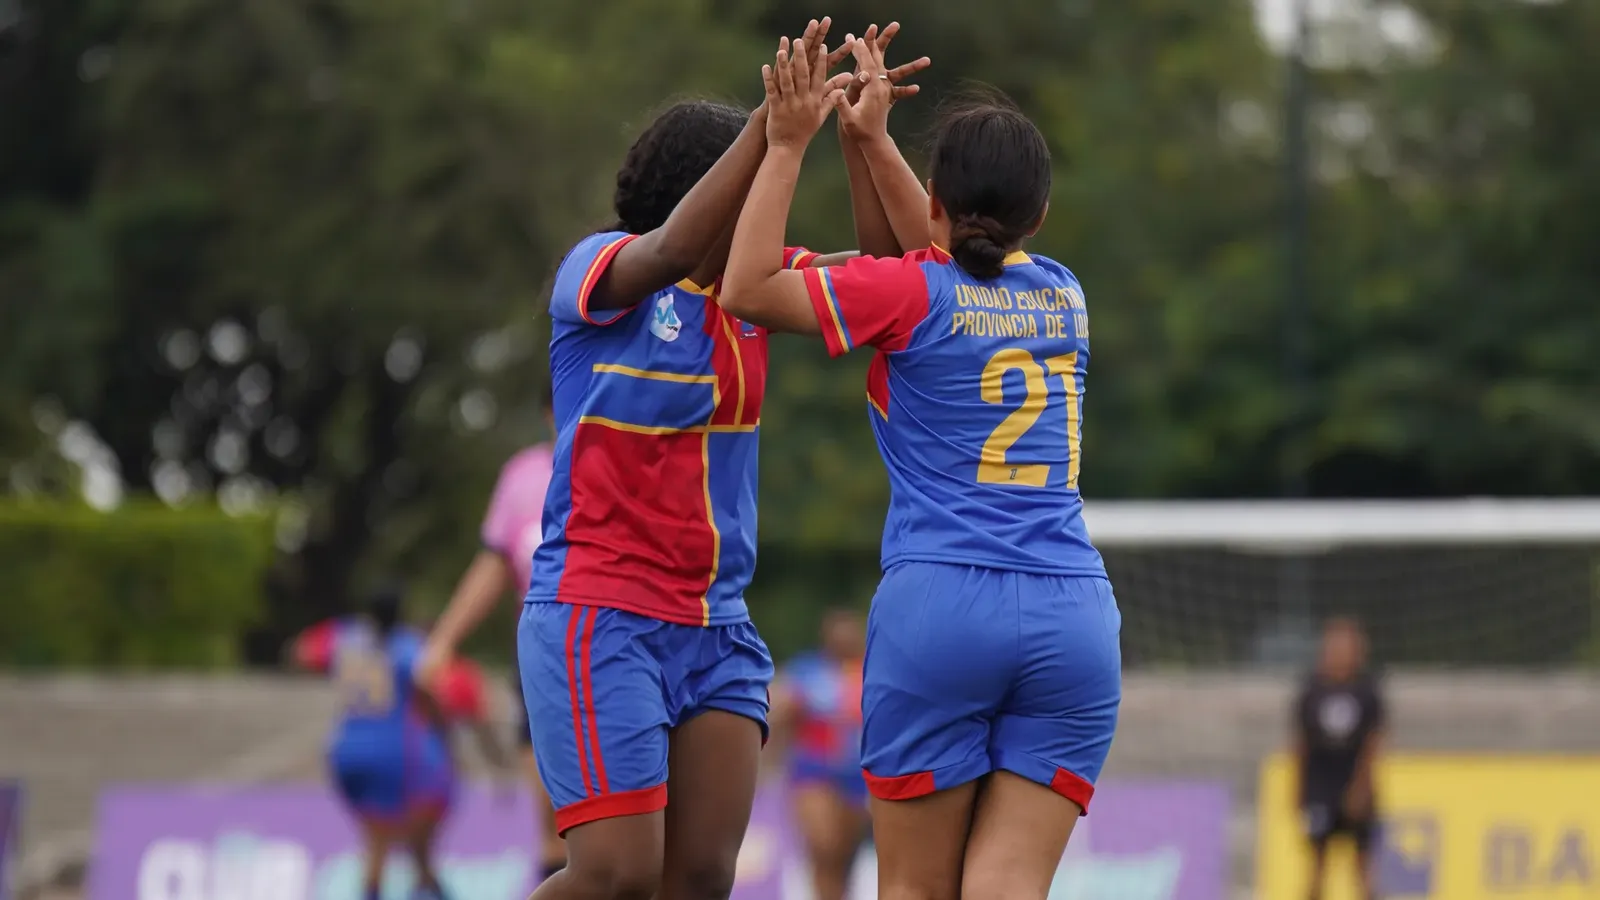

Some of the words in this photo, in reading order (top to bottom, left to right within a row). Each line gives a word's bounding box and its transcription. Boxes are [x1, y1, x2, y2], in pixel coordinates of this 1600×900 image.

[955, 284, 1013, 310] UNIDAD
[951, 310, 1038, 338] PROVINCIA
[1044, 313, 1068, 339] DE
[977, 348, 1079, 490] 21
